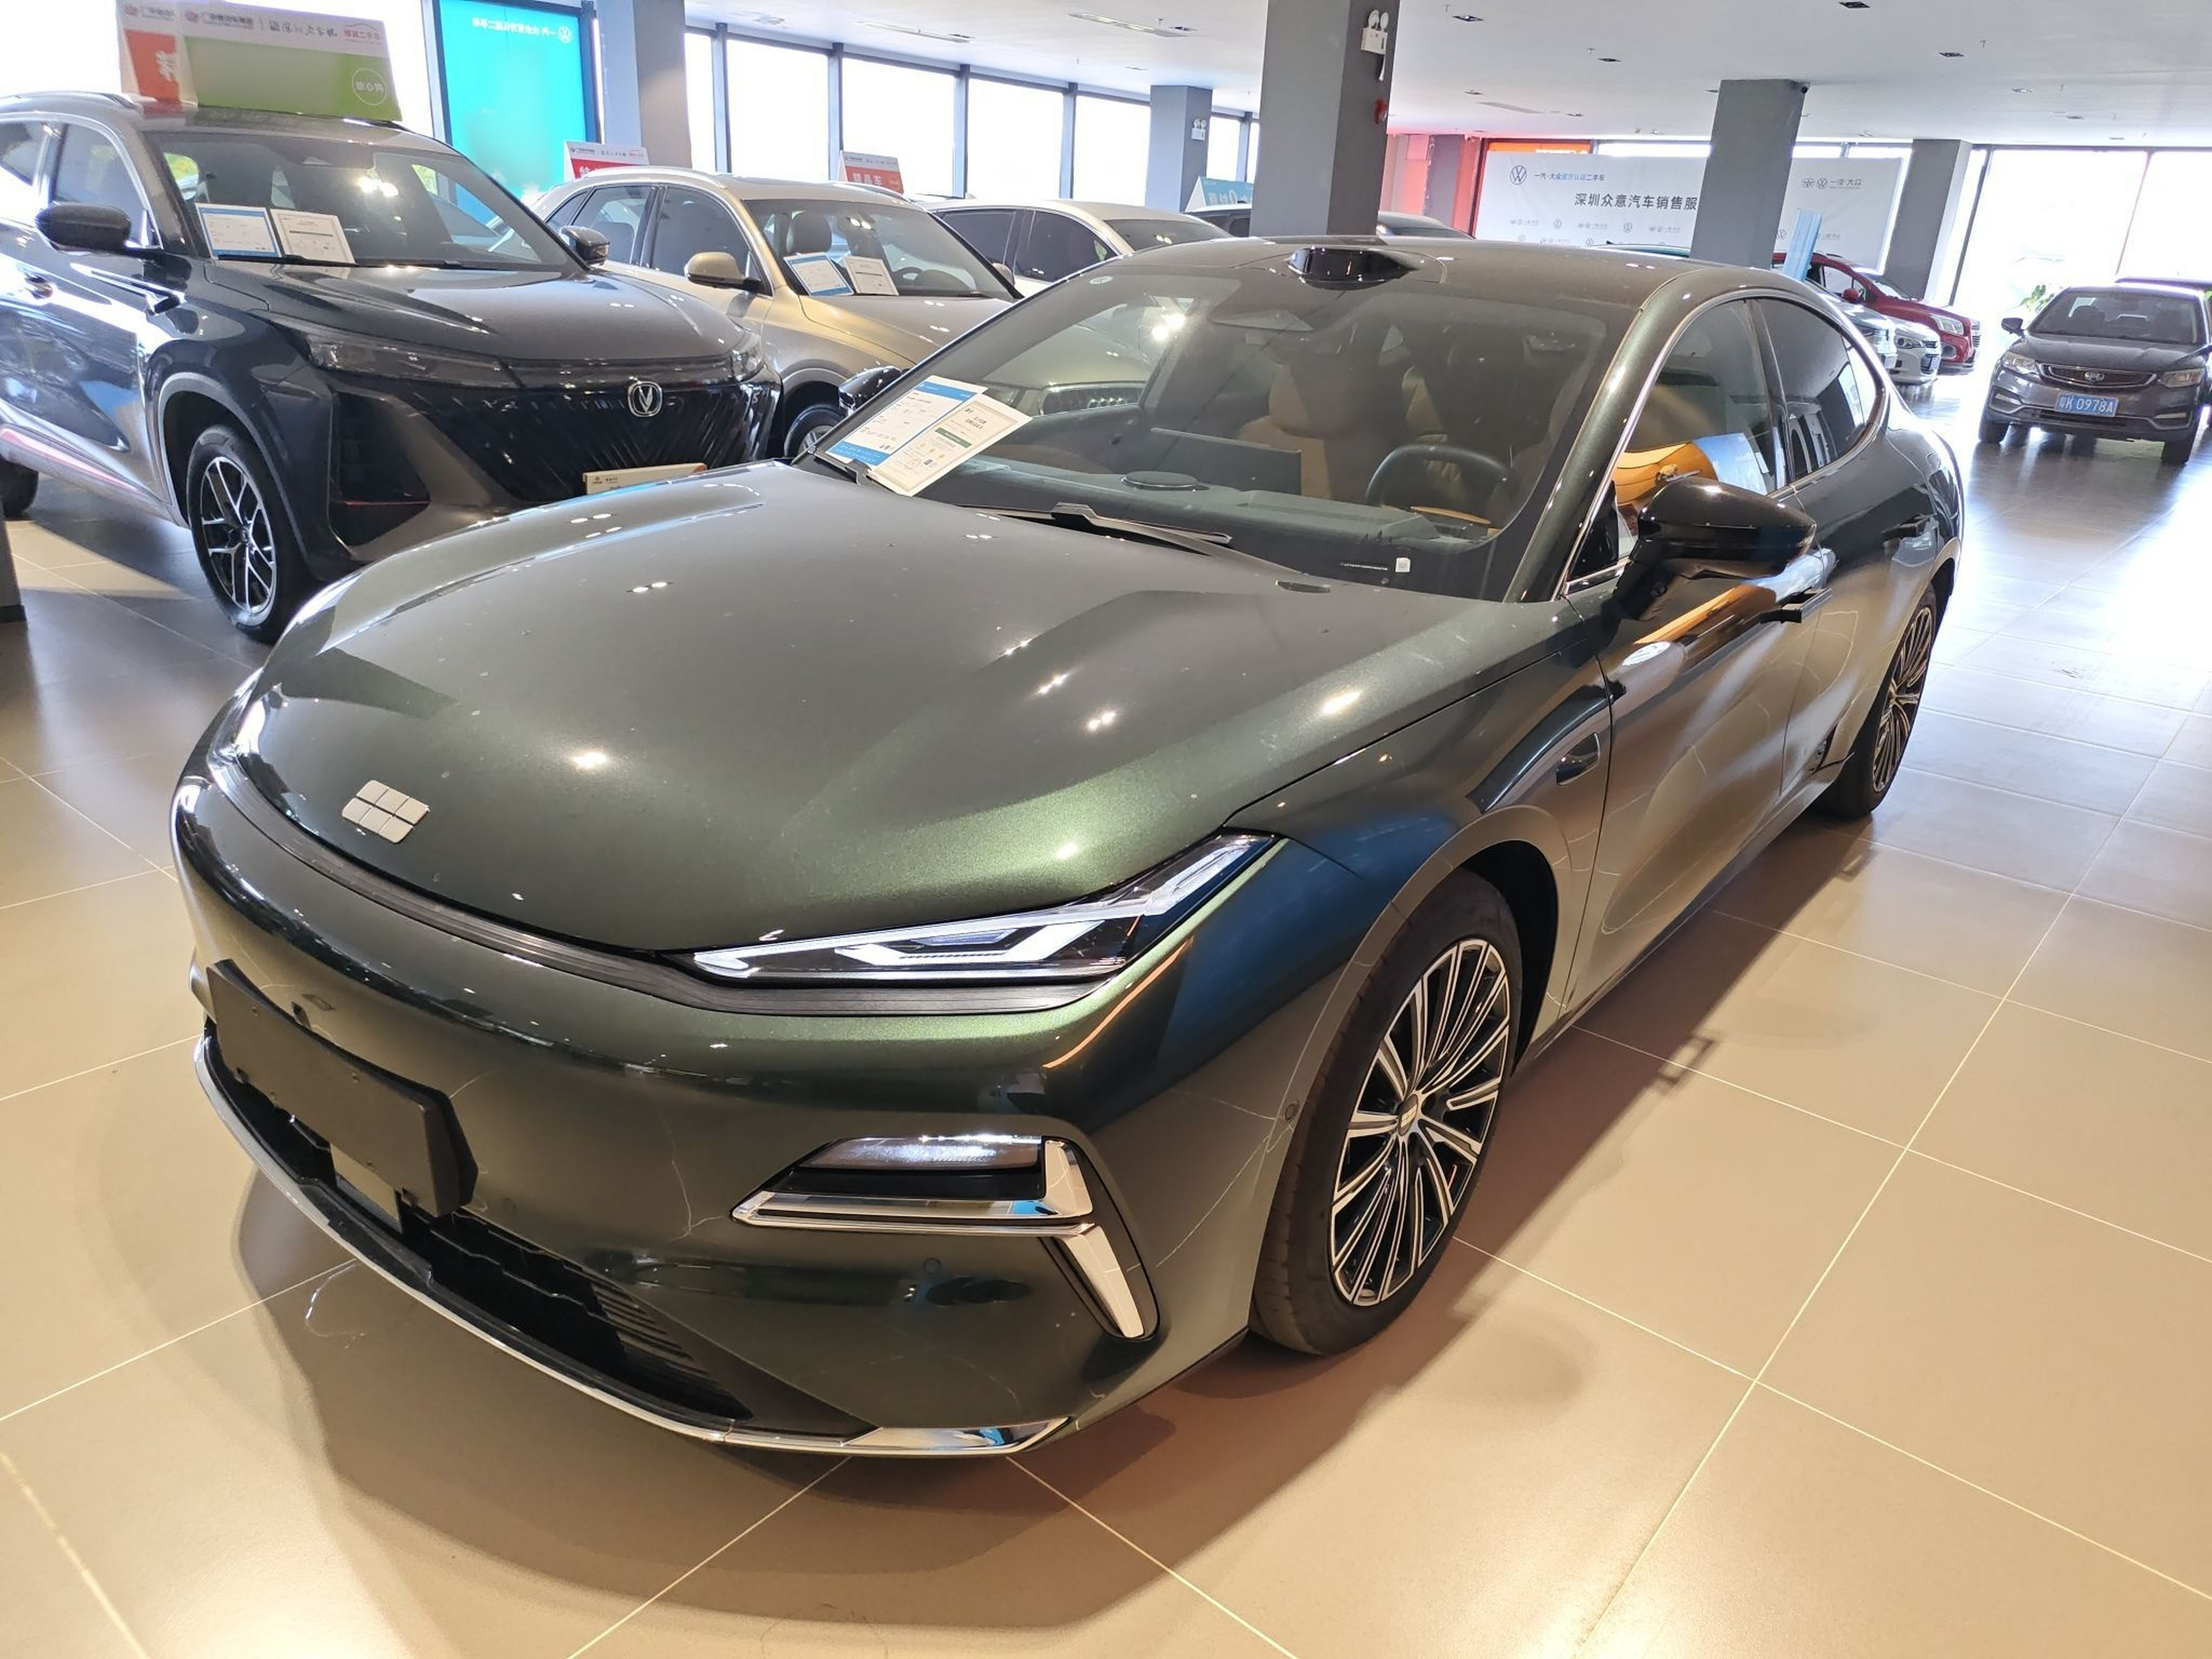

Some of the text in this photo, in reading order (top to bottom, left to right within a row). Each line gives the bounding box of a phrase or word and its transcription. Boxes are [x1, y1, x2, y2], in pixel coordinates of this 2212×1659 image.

[1574, 193, 1698, 211] 深圳众意汽车销售服
